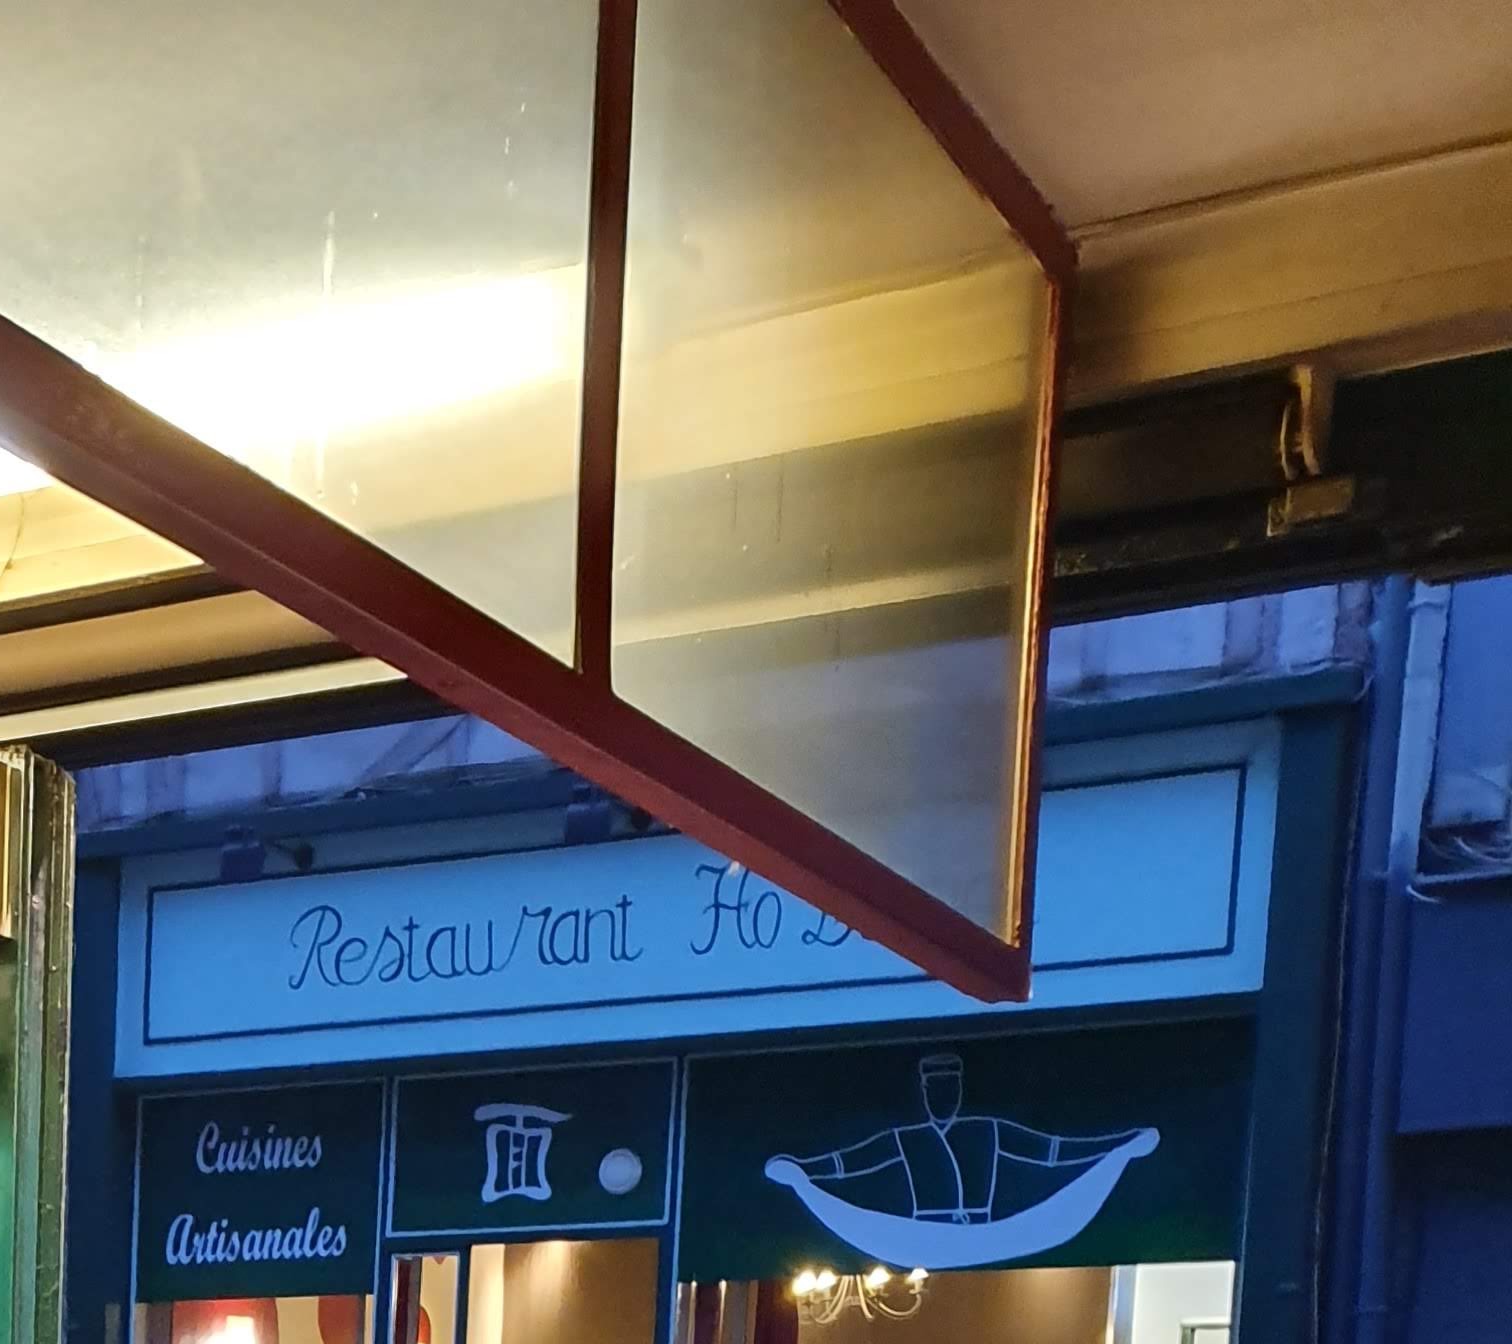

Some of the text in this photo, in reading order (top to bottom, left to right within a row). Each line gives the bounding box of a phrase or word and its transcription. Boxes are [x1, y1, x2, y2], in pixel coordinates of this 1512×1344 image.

[289, 894, 643, 989] Restaurant
[690, 862, 782, 955] Ho
[196, 1121, 322, 1174] Cuisines
[166, 1206, 347, 1265] Artisanales
